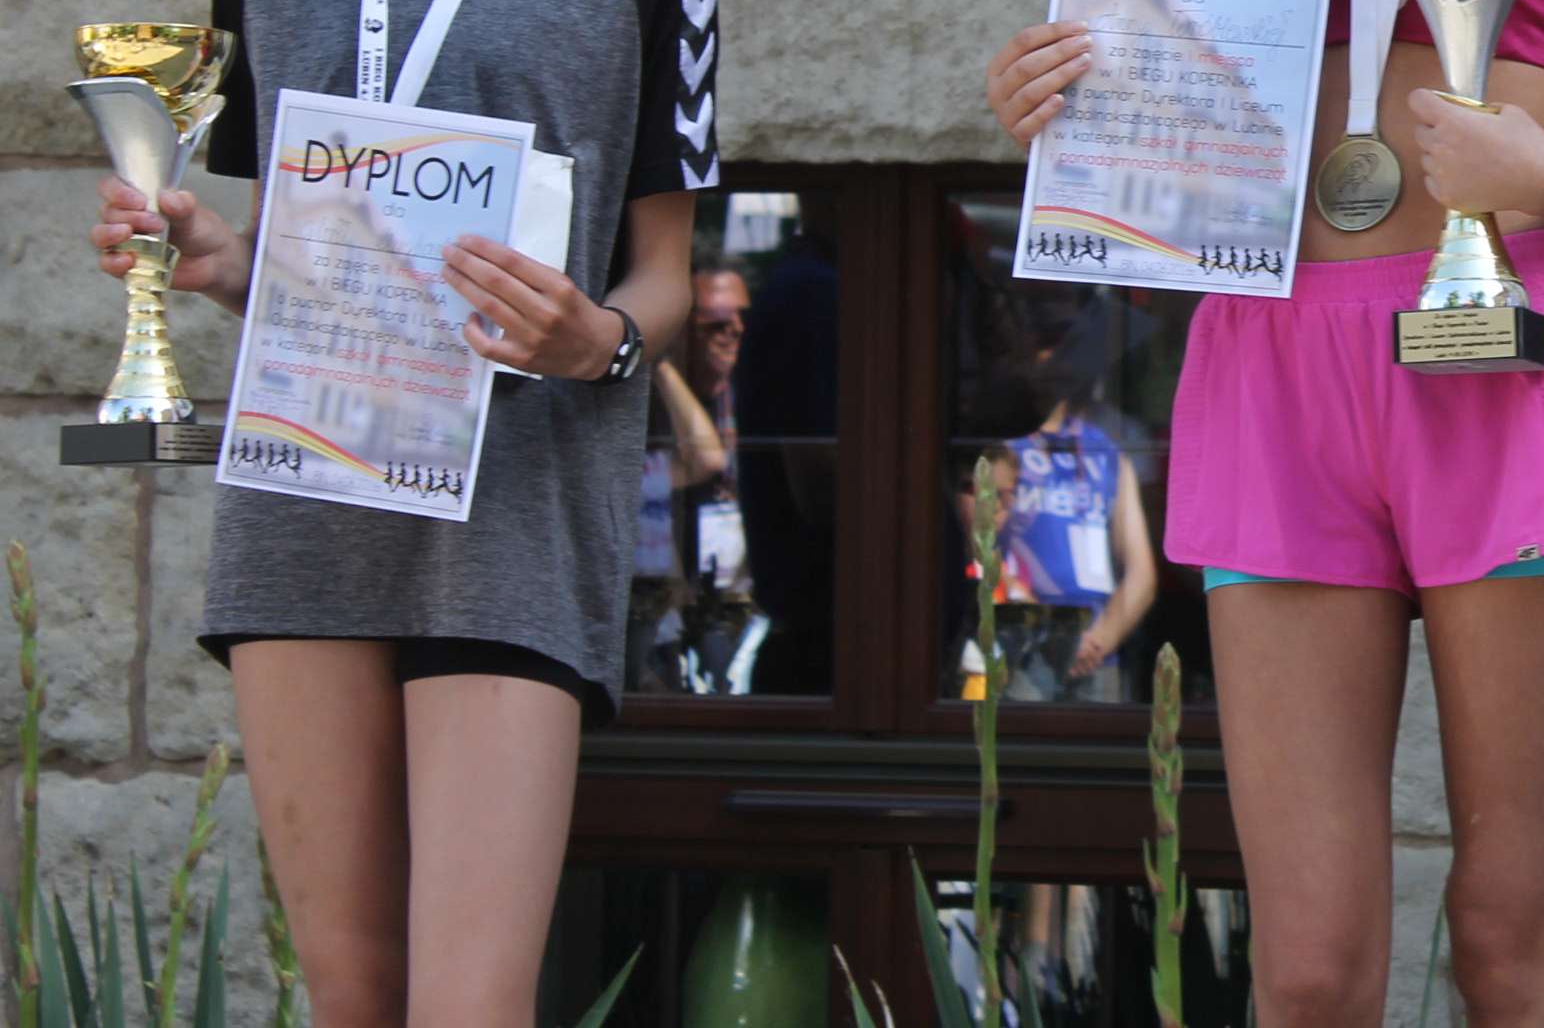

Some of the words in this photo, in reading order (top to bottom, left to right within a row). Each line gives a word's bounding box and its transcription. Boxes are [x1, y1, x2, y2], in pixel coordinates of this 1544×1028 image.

[1199, 51, 1255, 69] miejsca
[1127, 66, 1172, 83] BIEGU
[1178, 70, 1258, 89] KOPERNIKA
[1141, 89, 1215, 109] Dyrektora
[1230, 98, 1284, 114] Liceum
[1231, 120, 1284, 137] Lubinie
[1184, 139, 1288, 160] gimnazjalnych
[301, 139, 495, 209] DYPLOM
[1059, 152, 1209, 176] ponadgimnazjalnych
[376, 283, 447, 306] KOPERNIKA
